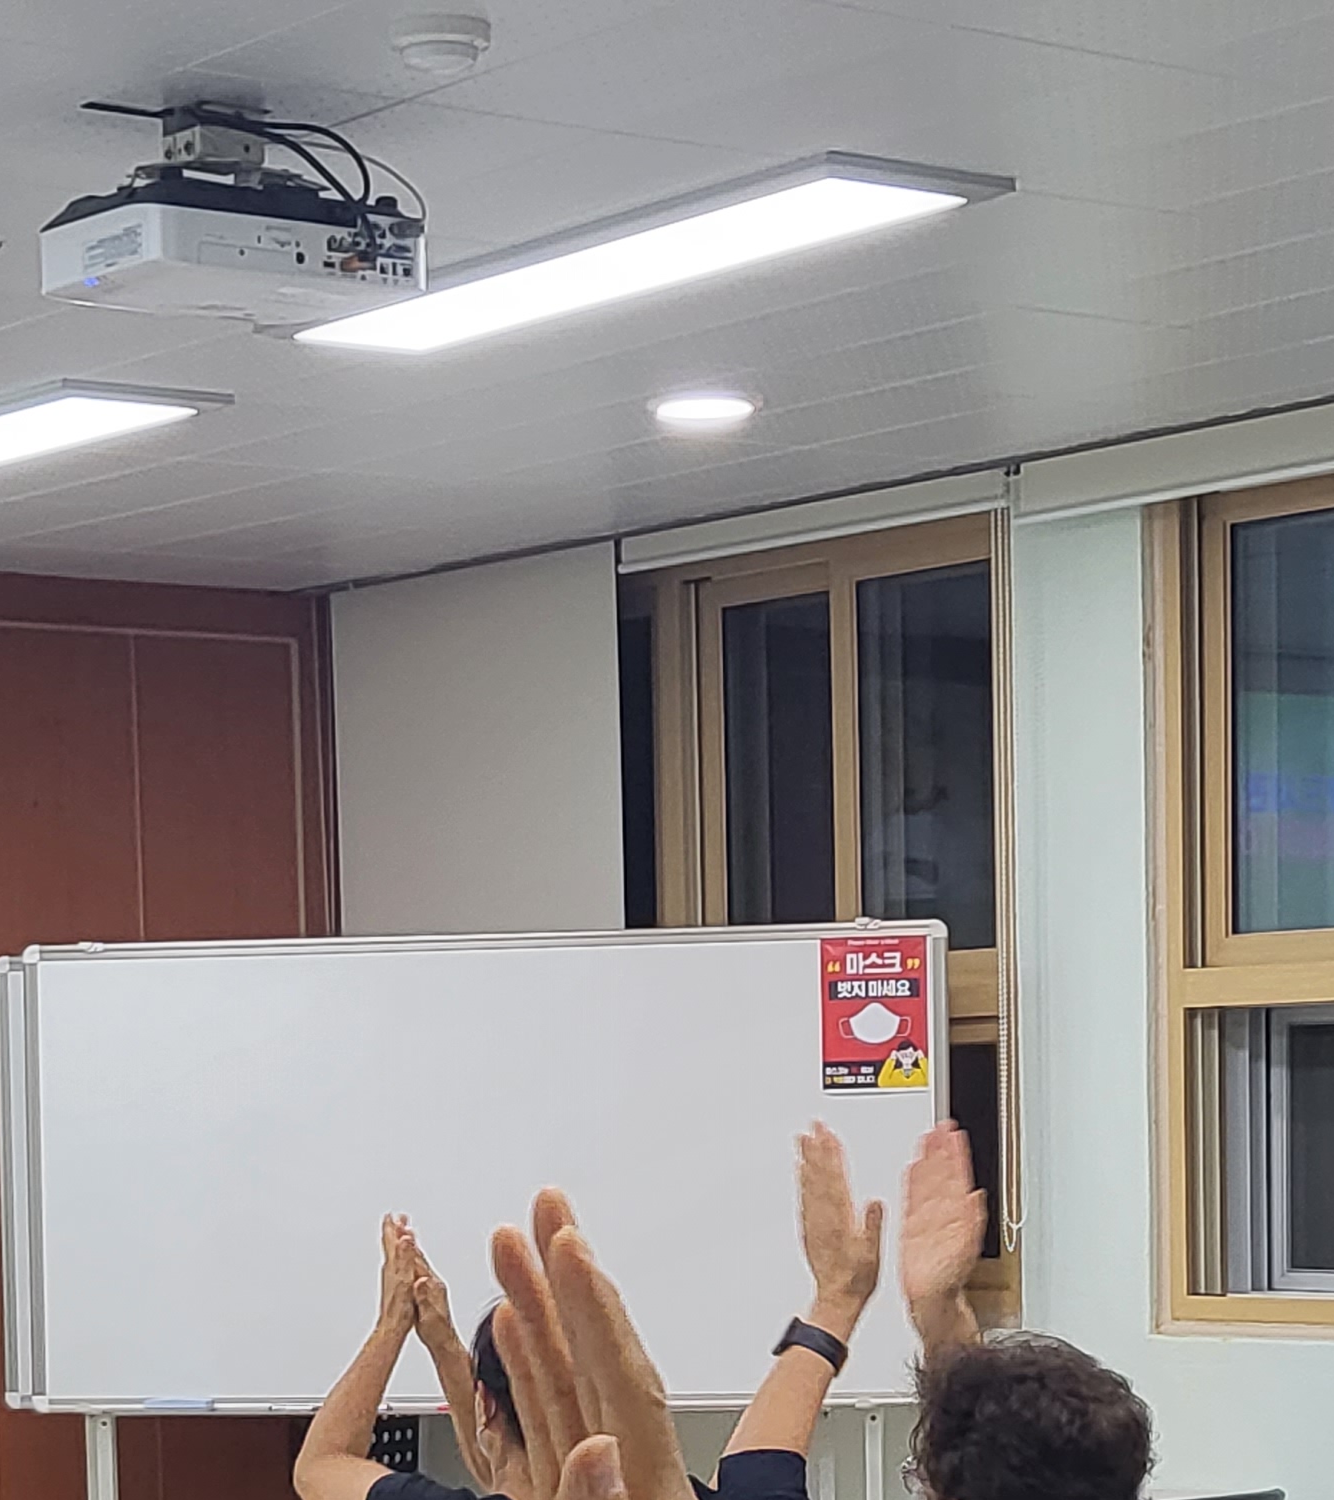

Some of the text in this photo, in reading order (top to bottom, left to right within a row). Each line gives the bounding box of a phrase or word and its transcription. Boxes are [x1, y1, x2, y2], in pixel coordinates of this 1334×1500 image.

[845, 952, 904, 975] 마스크
[837, 980, 911, 998] 벗지 마세요
